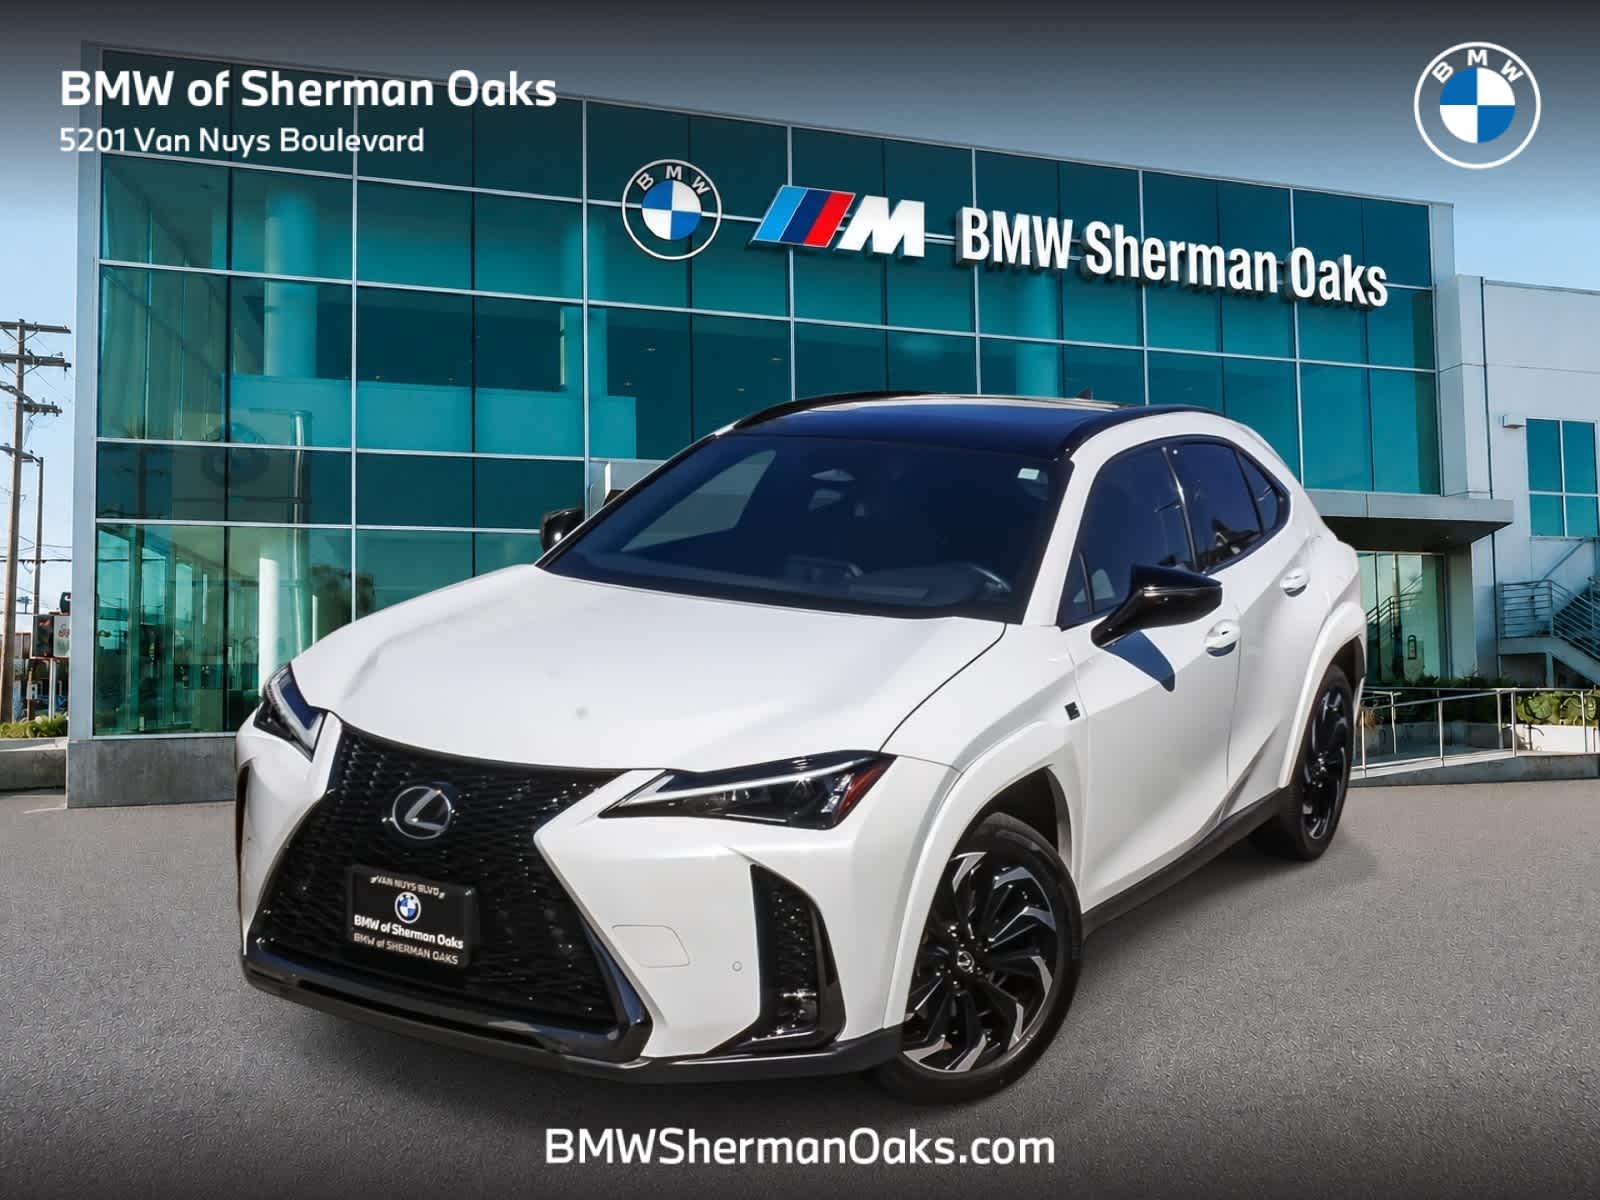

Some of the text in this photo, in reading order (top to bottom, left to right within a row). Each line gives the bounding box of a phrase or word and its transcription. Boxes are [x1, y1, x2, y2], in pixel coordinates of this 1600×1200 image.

[636, 165, 710, 196] BMW
[833, 194, 925, 258] M
[960, 205, 1388, 308] BMW Sherman Oaks
[375, 875, 440, 897] VAN NUYS BLVD
[353, 914, 464, 950] BMW of Sherman Oaks
[353, 932, 459, 965] BMW of SHERMAN OAKS
